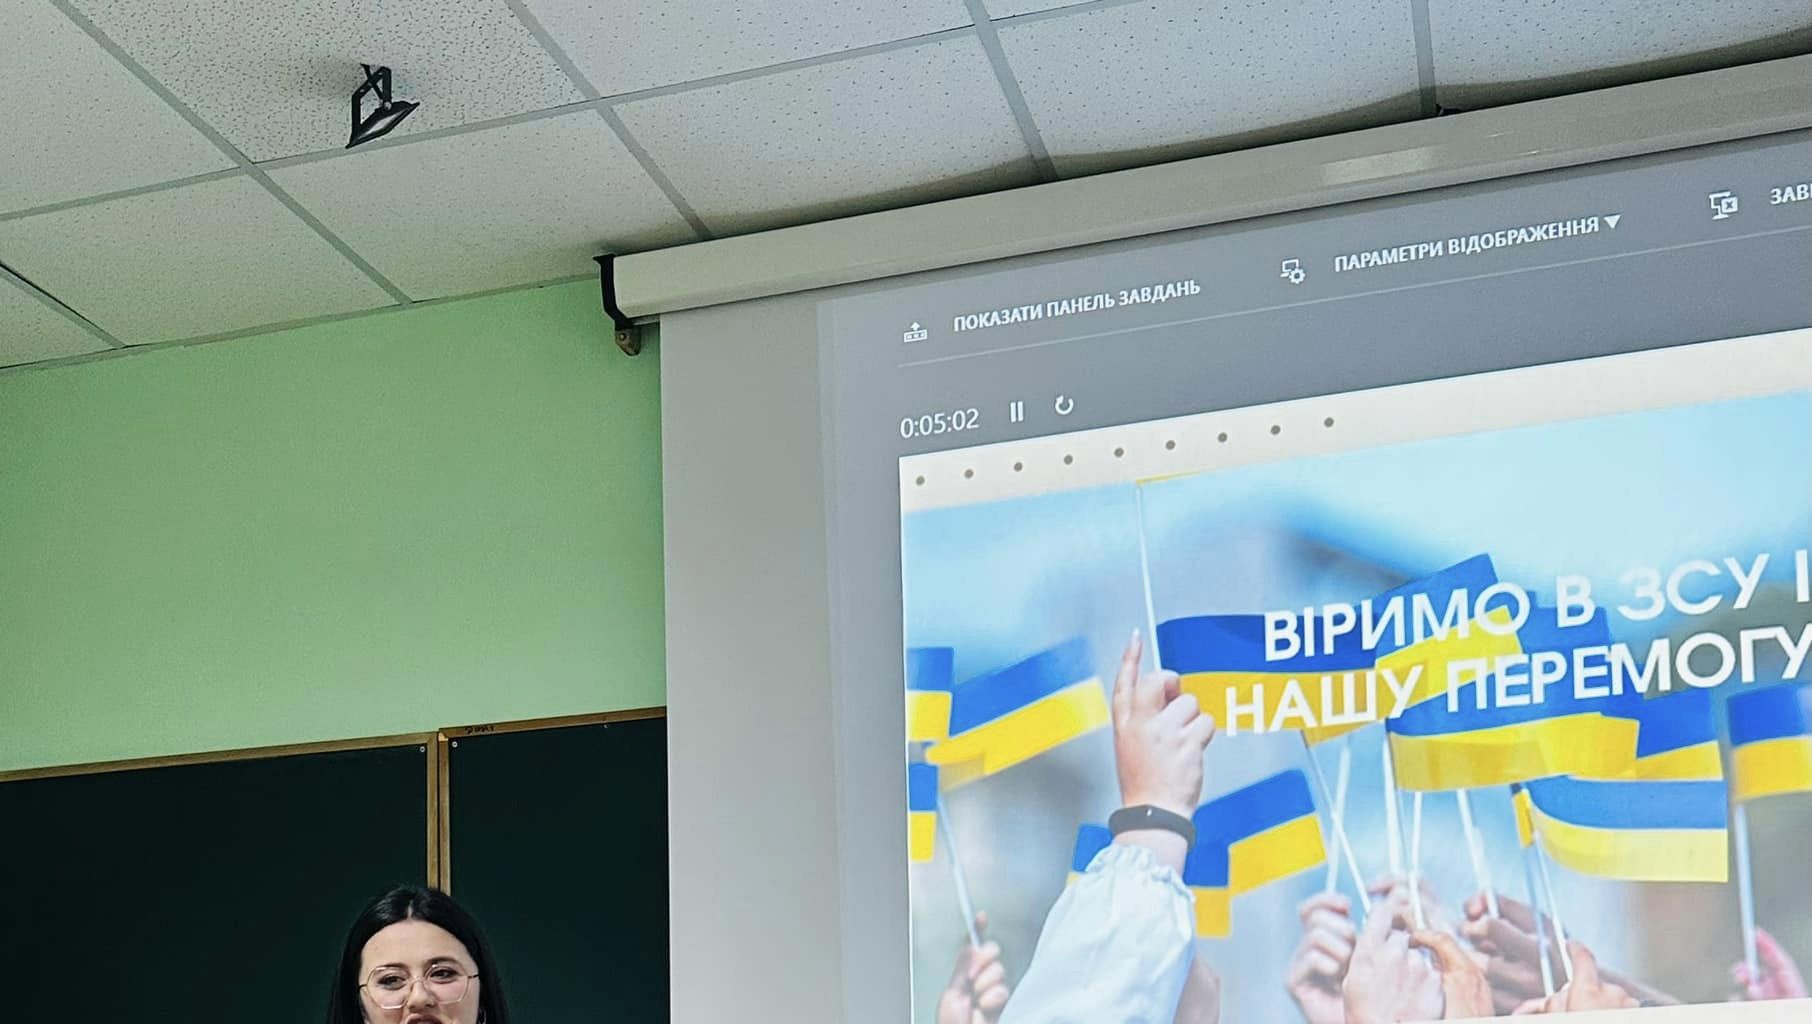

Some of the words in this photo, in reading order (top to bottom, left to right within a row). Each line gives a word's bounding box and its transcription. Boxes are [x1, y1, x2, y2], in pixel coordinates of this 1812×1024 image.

[1770, 183, 1812, 205] ЗАВ
[1334, 241, 1443, 273] ПАРАМЕТРИ
[1448, 216, 1600, 256] ВІДОБРАЖЕННЯ
[953, 304, 1044, 333] ПОКАЗАТИ
[1046, 293, 1116, 318] ПАНЕЛЬ
[1118, 278, 1201, 307] ЗАВДАНЬ
[900, 408, 980, 439] 0:05:02
[1264, 584, 1531, 662] ВІРИМО
[1556, 575, 1597, 628] В
[1616, 552, 1771, 622] ЗСУ
[1795, 549, 1810, 603] І
[1225, 665, 1424, 737] НАШУ
[1446, 622, 1812, 713] ПЕРЕМОГУ
